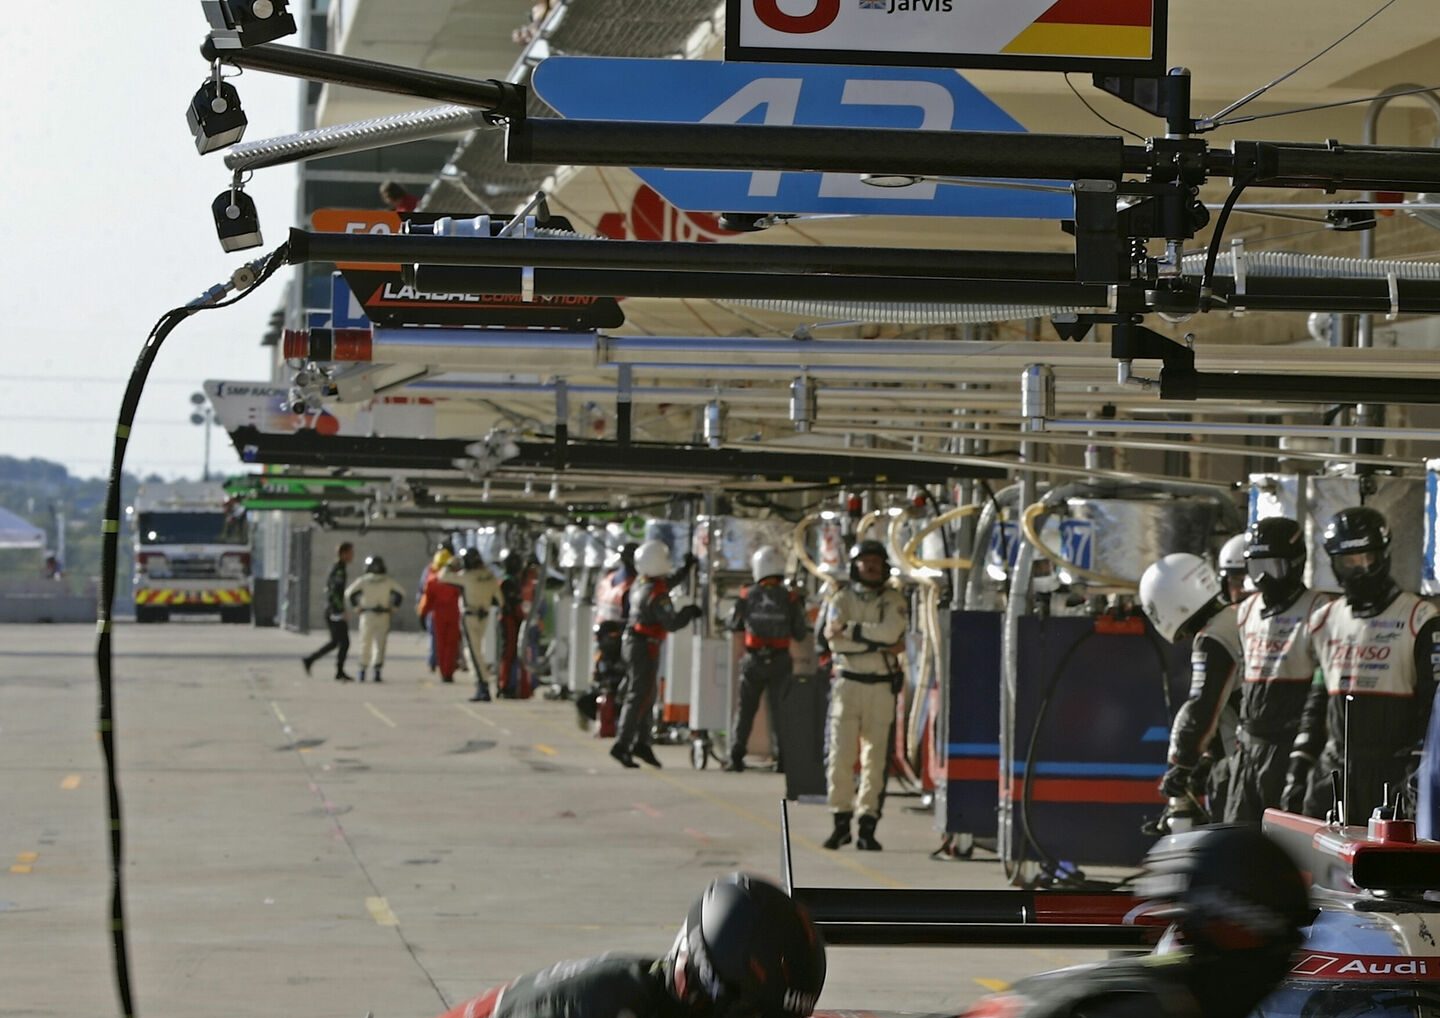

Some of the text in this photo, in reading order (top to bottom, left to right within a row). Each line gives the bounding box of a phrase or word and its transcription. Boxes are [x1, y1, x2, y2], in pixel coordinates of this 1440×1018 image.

[887, 0, 953, 14] Jarvis
[664, 78, 954, 200] 42
[1331, 645, 1391, 661] DENSO
[1337, 958, 1427, 975] Audi
